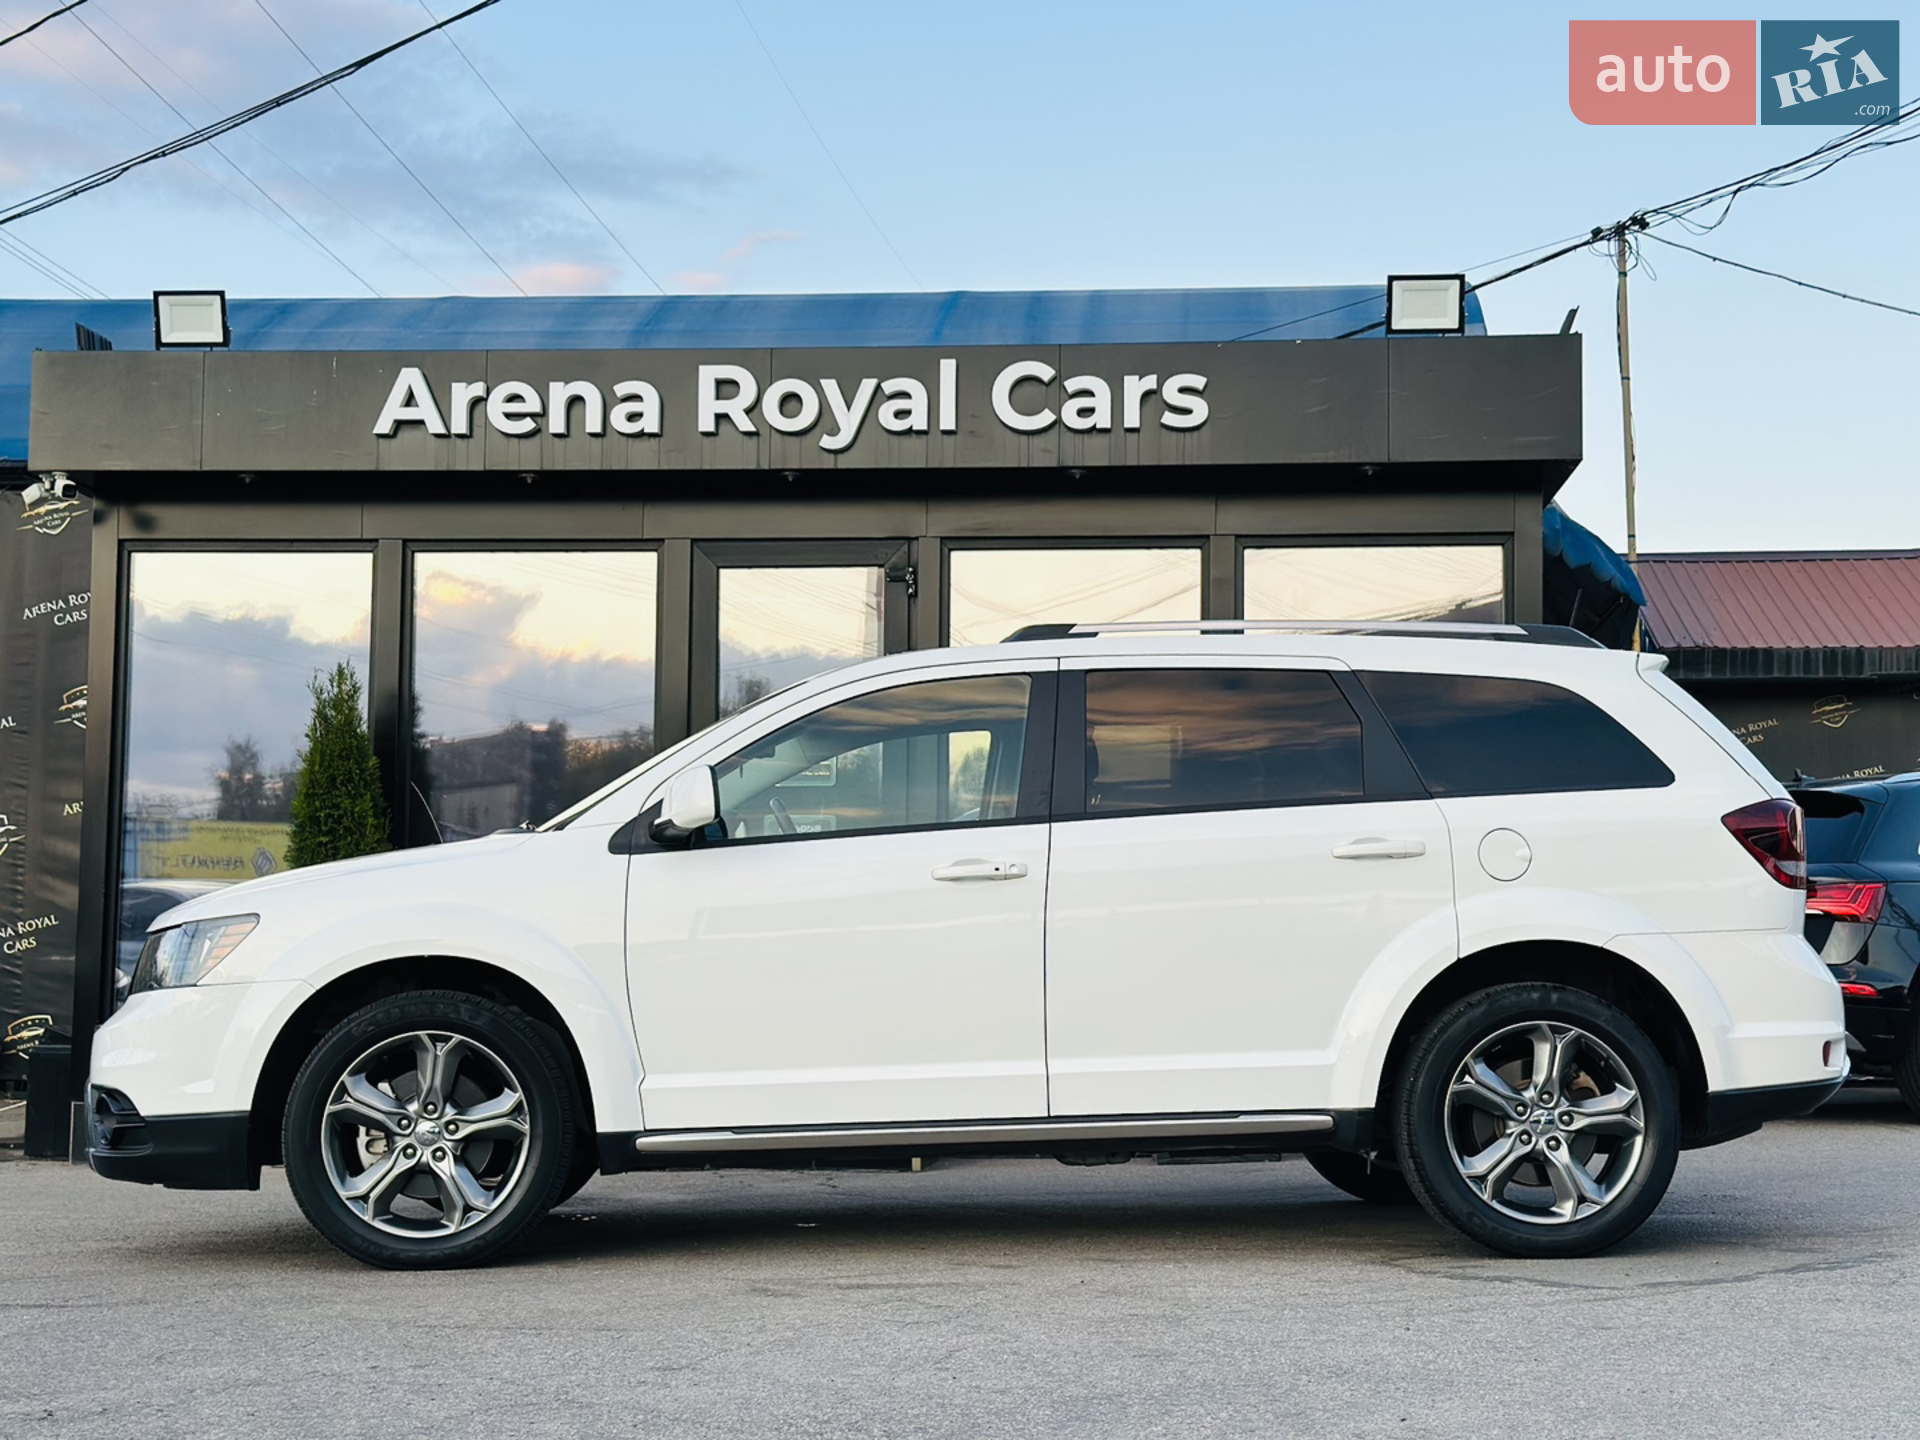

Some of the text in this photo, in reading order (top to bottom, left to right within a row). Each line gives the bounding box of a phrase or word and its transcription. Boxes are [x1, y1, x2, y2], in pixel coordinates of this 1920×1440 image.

[373, 358, 1210, 453] Arena Royal Cars
[23, 598, 67, 620] ARENA
[53, 608, 88, 626] CARS
[1748, 718, 1779, 732] ROYAL
[1853, 764, 1886, 778] ROYAL
[17, 914, 60, 935] ROYAL
[3, 936, 37, 954] CARS
